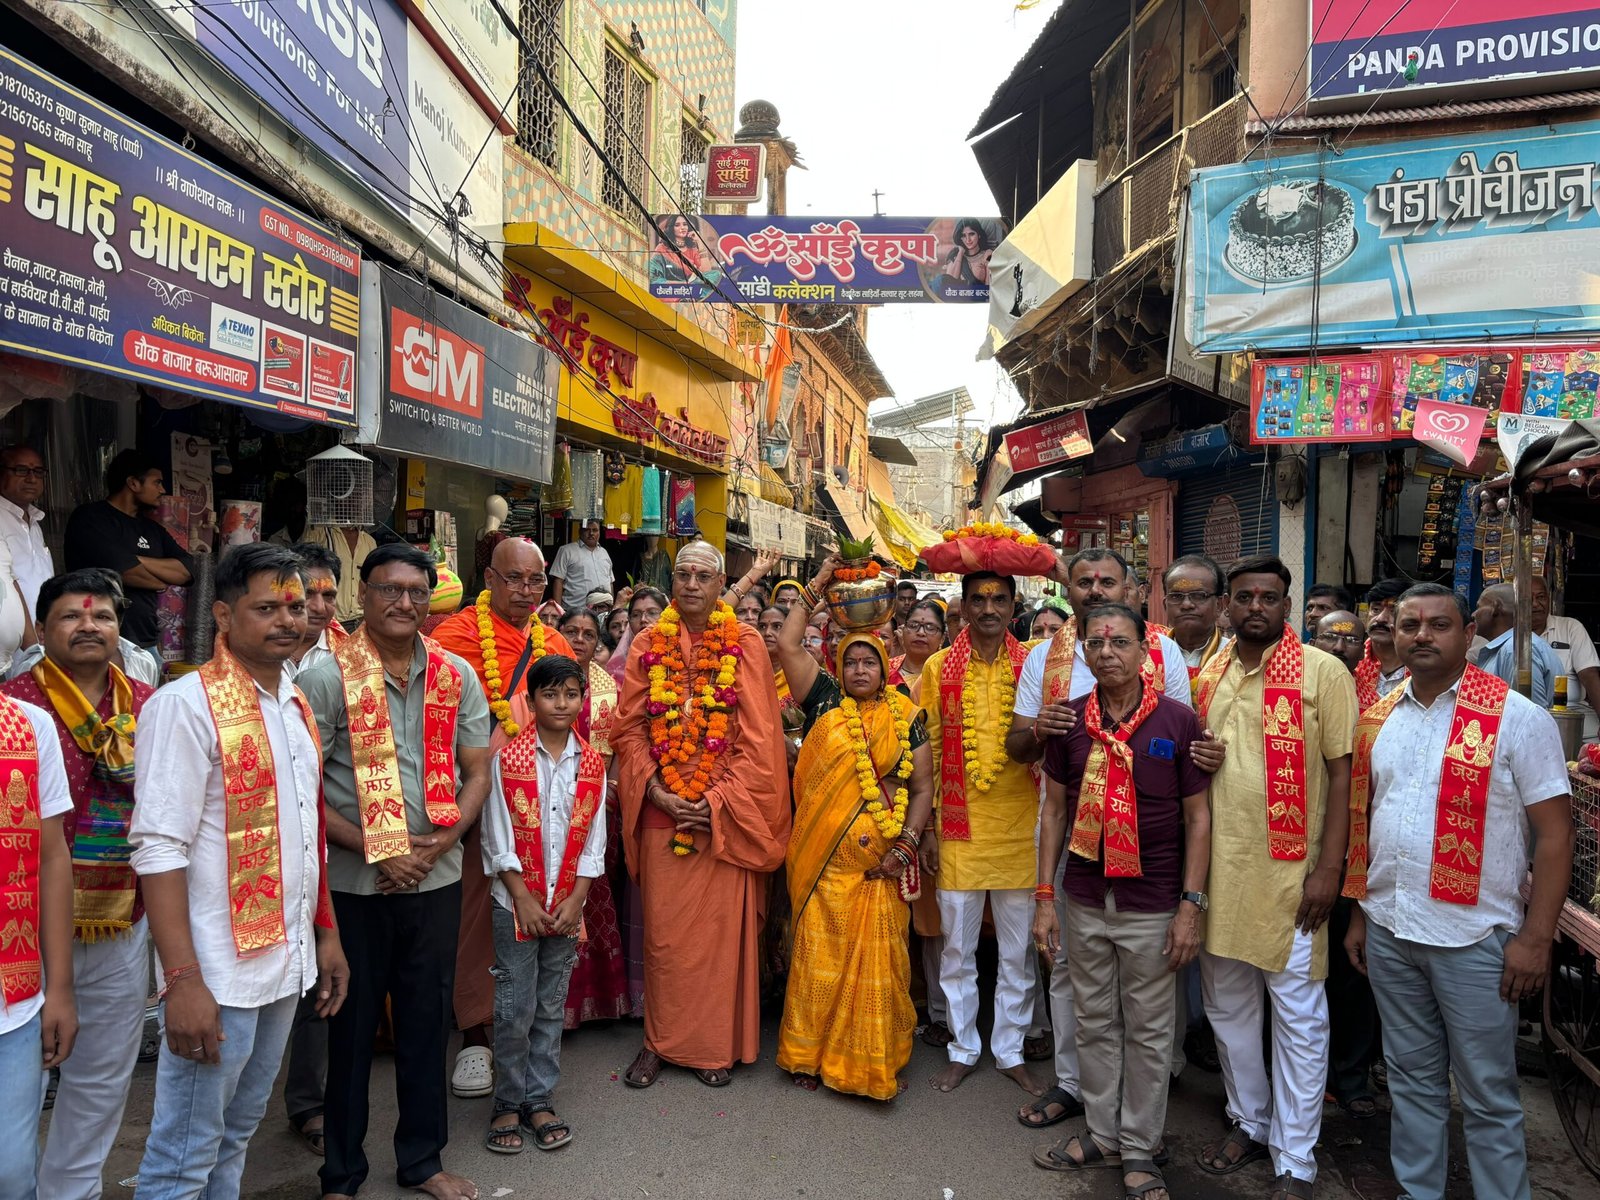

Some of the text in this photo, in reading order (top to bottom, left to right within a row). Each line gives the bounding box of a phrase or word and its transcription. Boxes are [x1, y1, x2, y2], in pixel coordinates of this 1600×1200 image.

[231, 0, 387, 149] olutions. For Life.
[1348, 44, 1445, 79] PANDA
[415, 80, 444, 142] Manoj
[54, 126, 75, 150] रमन
[76, 137, 93, 163] साहू
[79, 113, 102, 136] कुमार
[103, 127, 119, 151] साहू
[166, 170, 178, 190] श्री
[180, 179, 215, 208] गणेशाय
[1374, 167, 1440, 226] पंडा
[24, 142, 327, 325] साहू आयरन स्टोर
[264, 215, 278, 231] GST
[859, 233, 939, 276] कृपा
[11, 277, 48, 304] हार्डवेयर
[89, 302, 110, 322] पाईप
[4, 301, 16, 320] के
[18, 308, 50, 330] सामान
[53, 314, 64, 333] के
[65, 317, 85, 338] थोक
[228, 319, 254, 337] TEXMO
[134, 336, 159, 363] चौक
[163, 349, 192, 373] बाजार
[195, 358, 249, 386] बरूआसागर
[399, 326, 479, 407] GM
[389, 399, 483, 437] SWITCH TO A BETTER WORLD
[492, 387, 551, 424] ELECTRICALS
[1505, 417, 1518, 428] M
[1523, 427, 1560, 436] CHOCOLATE
[1524, 422, 1551, 430] BELGIAN
[1423, 429, 1467, 446] KWALITY
[429, 707, 449, 724] जय
[429, 752, 449, 767] राम
[1271, 738, 1298, 756] जय
[1276, 756, 1295, 782] श्री
[1451, 762, 1481, 786] जय
[1115, 774, 1131, 800] श्री
[1273, 781, 1300, 798] राम
[1450, 786, 1472, 814] श्री
[1110, 797, 1132, 816] राम
[1446, 809, 1478, 833] राम
[1, 833, 33, 851] जय
[515, 829, 535, 844] जय
[7, 854, 27, 887] श्री
[4, 892, 33, 911] राम
